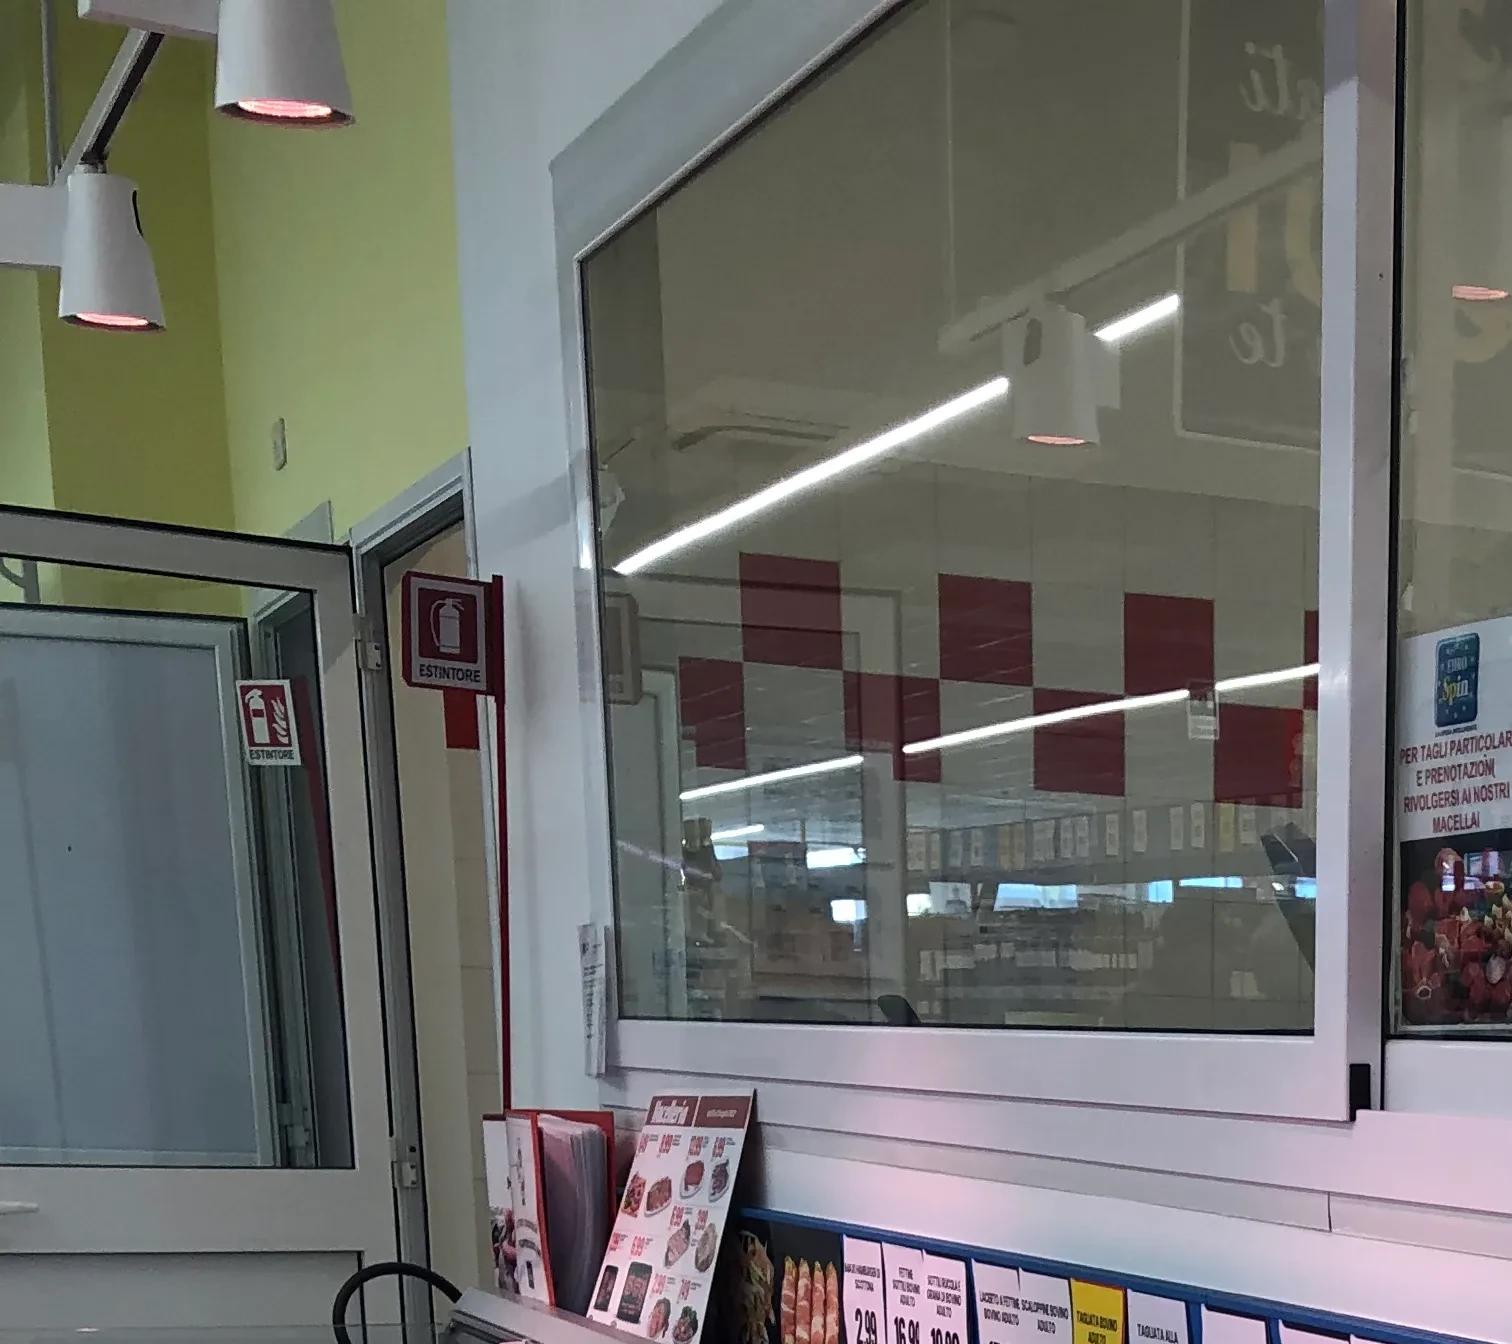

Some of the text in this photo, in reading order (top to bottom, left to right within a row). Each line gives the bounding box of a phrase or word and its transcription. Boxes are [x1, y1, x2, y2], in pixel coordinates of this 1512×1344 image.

[420, 664, 481, 682] ESTINTORE
[1400, 747, 1418, 764] PER
[1421, 743, 1447, 761] TAGLI
[1416, 770, 1422, 786] E
[1404, 789, 1459, 813] RIVOLGERSI
[1473, 782, 1510, 802] NOSTRI
[1433, 812, 1480, 833] MACELLAI
